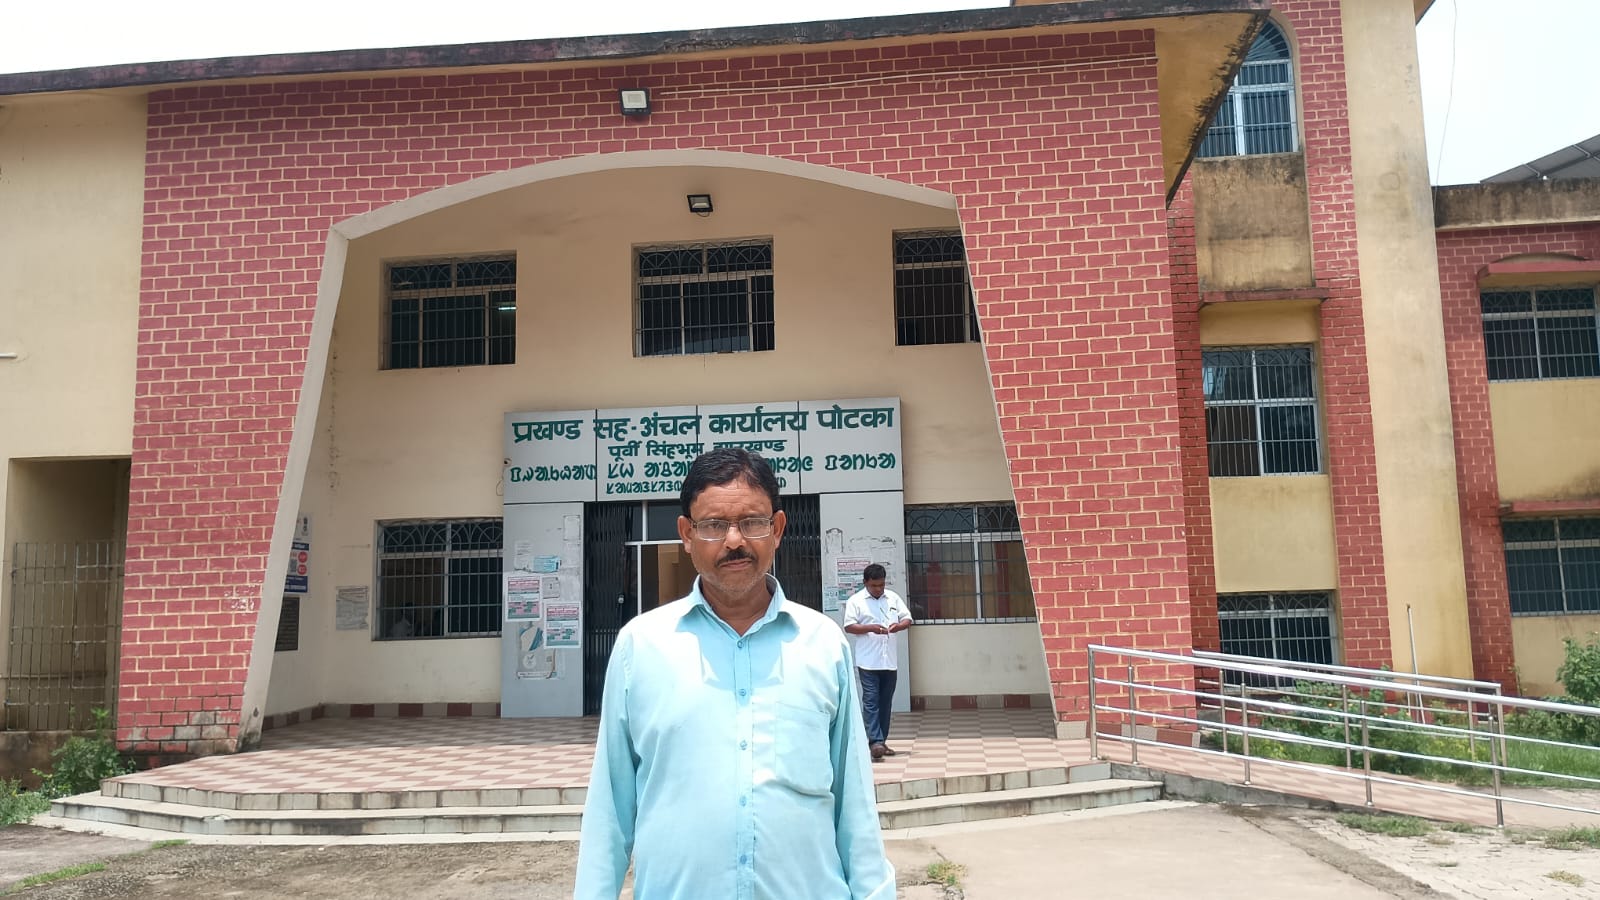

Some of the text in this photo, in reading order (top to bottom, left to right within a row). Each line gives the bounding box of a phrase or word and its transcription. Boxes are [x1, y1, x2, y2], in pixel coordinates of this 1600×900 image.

[511, 419, 584, 443] प्रखण्ड
[708, 405, 810, 434] कार्यालय
[816, 404, 895, 430] पोटका
[607, 440, 642, 462] पूर्वी
[645, 440, 704, 460] सिंहभूम
